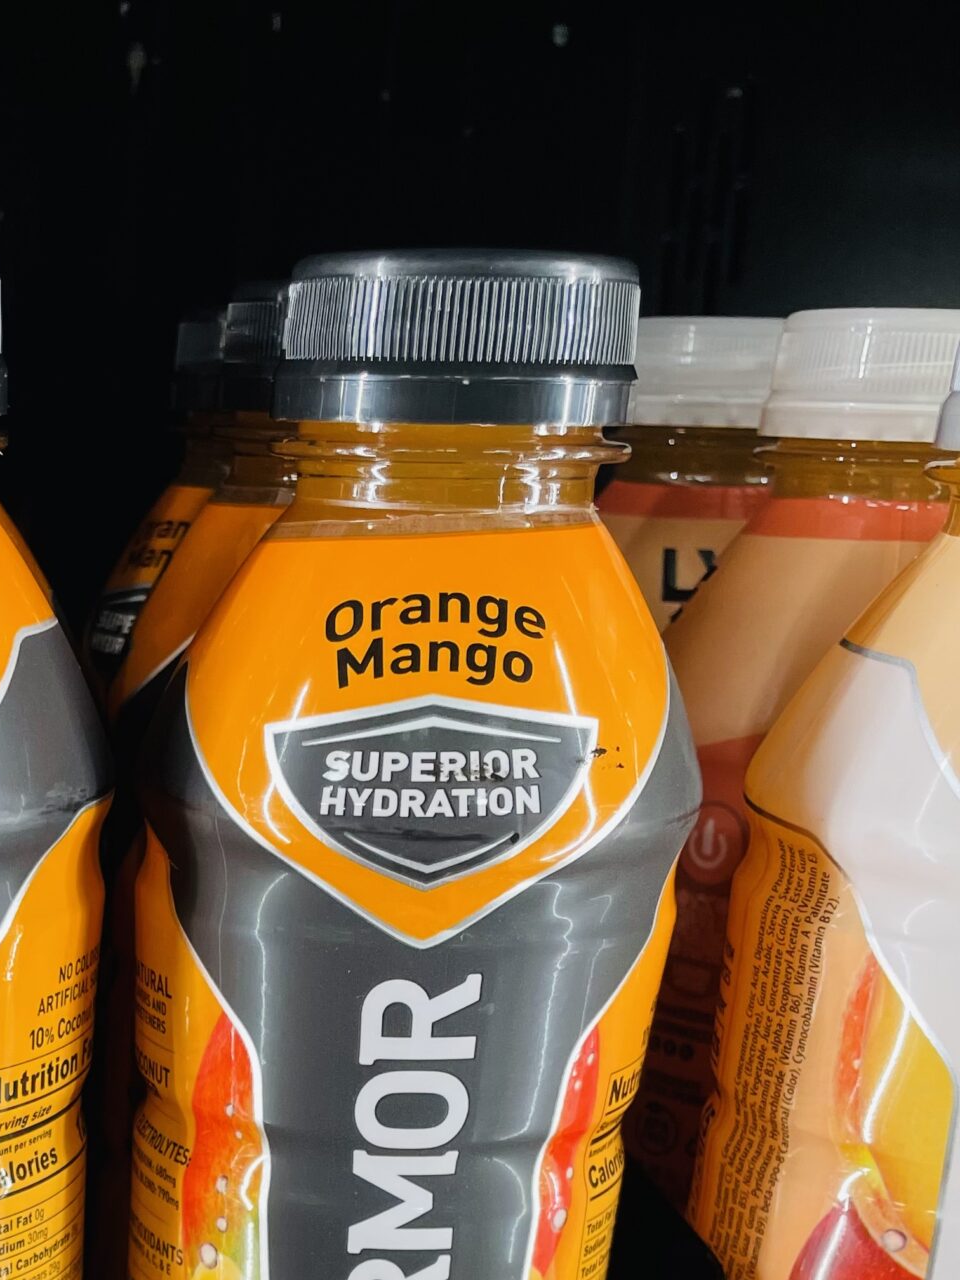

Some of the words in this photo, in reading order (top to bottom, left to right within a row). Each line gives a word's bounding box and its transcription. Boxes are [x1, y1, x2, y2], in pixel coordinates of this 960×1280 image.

[325, 591, 546, 643] Orange
[336, 636, 533, 690] Mango
[322, 749, 540, 784] SUPERIOR
[319, 785, 542, 819] HYDRATION
[789, 876, 804, 904] Ester
[766, 904, 781, 937] Stevia
[785, 914, 803, 959] Acetate
[796, 863, 819, 914] (Vitamin
[59, 963, 73, 984] NO
[767, 948, 784, 1014] Concentrate
[37, 983, 89, 1016] ARTIFICIAL
[782, 1067, 802, 1106] (Color),
[792, 975, 818, 1065] Cyanocobalamin
[809, 925, 827, 975] (Vitamin
[29, 1026, 55, 1050] 10%
[751, 1142, 776, 1199] Pyridoxine
[780, 1017, 798, 1066] (Vitamin
[794, 942, 810, 987] Vitamin
[804, 870, 831, 926] Palmitate
[763, 1015, 774, 1044] Juice
[750, 1044, 768, 1097] Vegetable
[32, 1104, 53, 1123] size
[16, 1213, 33, 1229] Fat
[27, 1226, 49, 1245] 30mg
